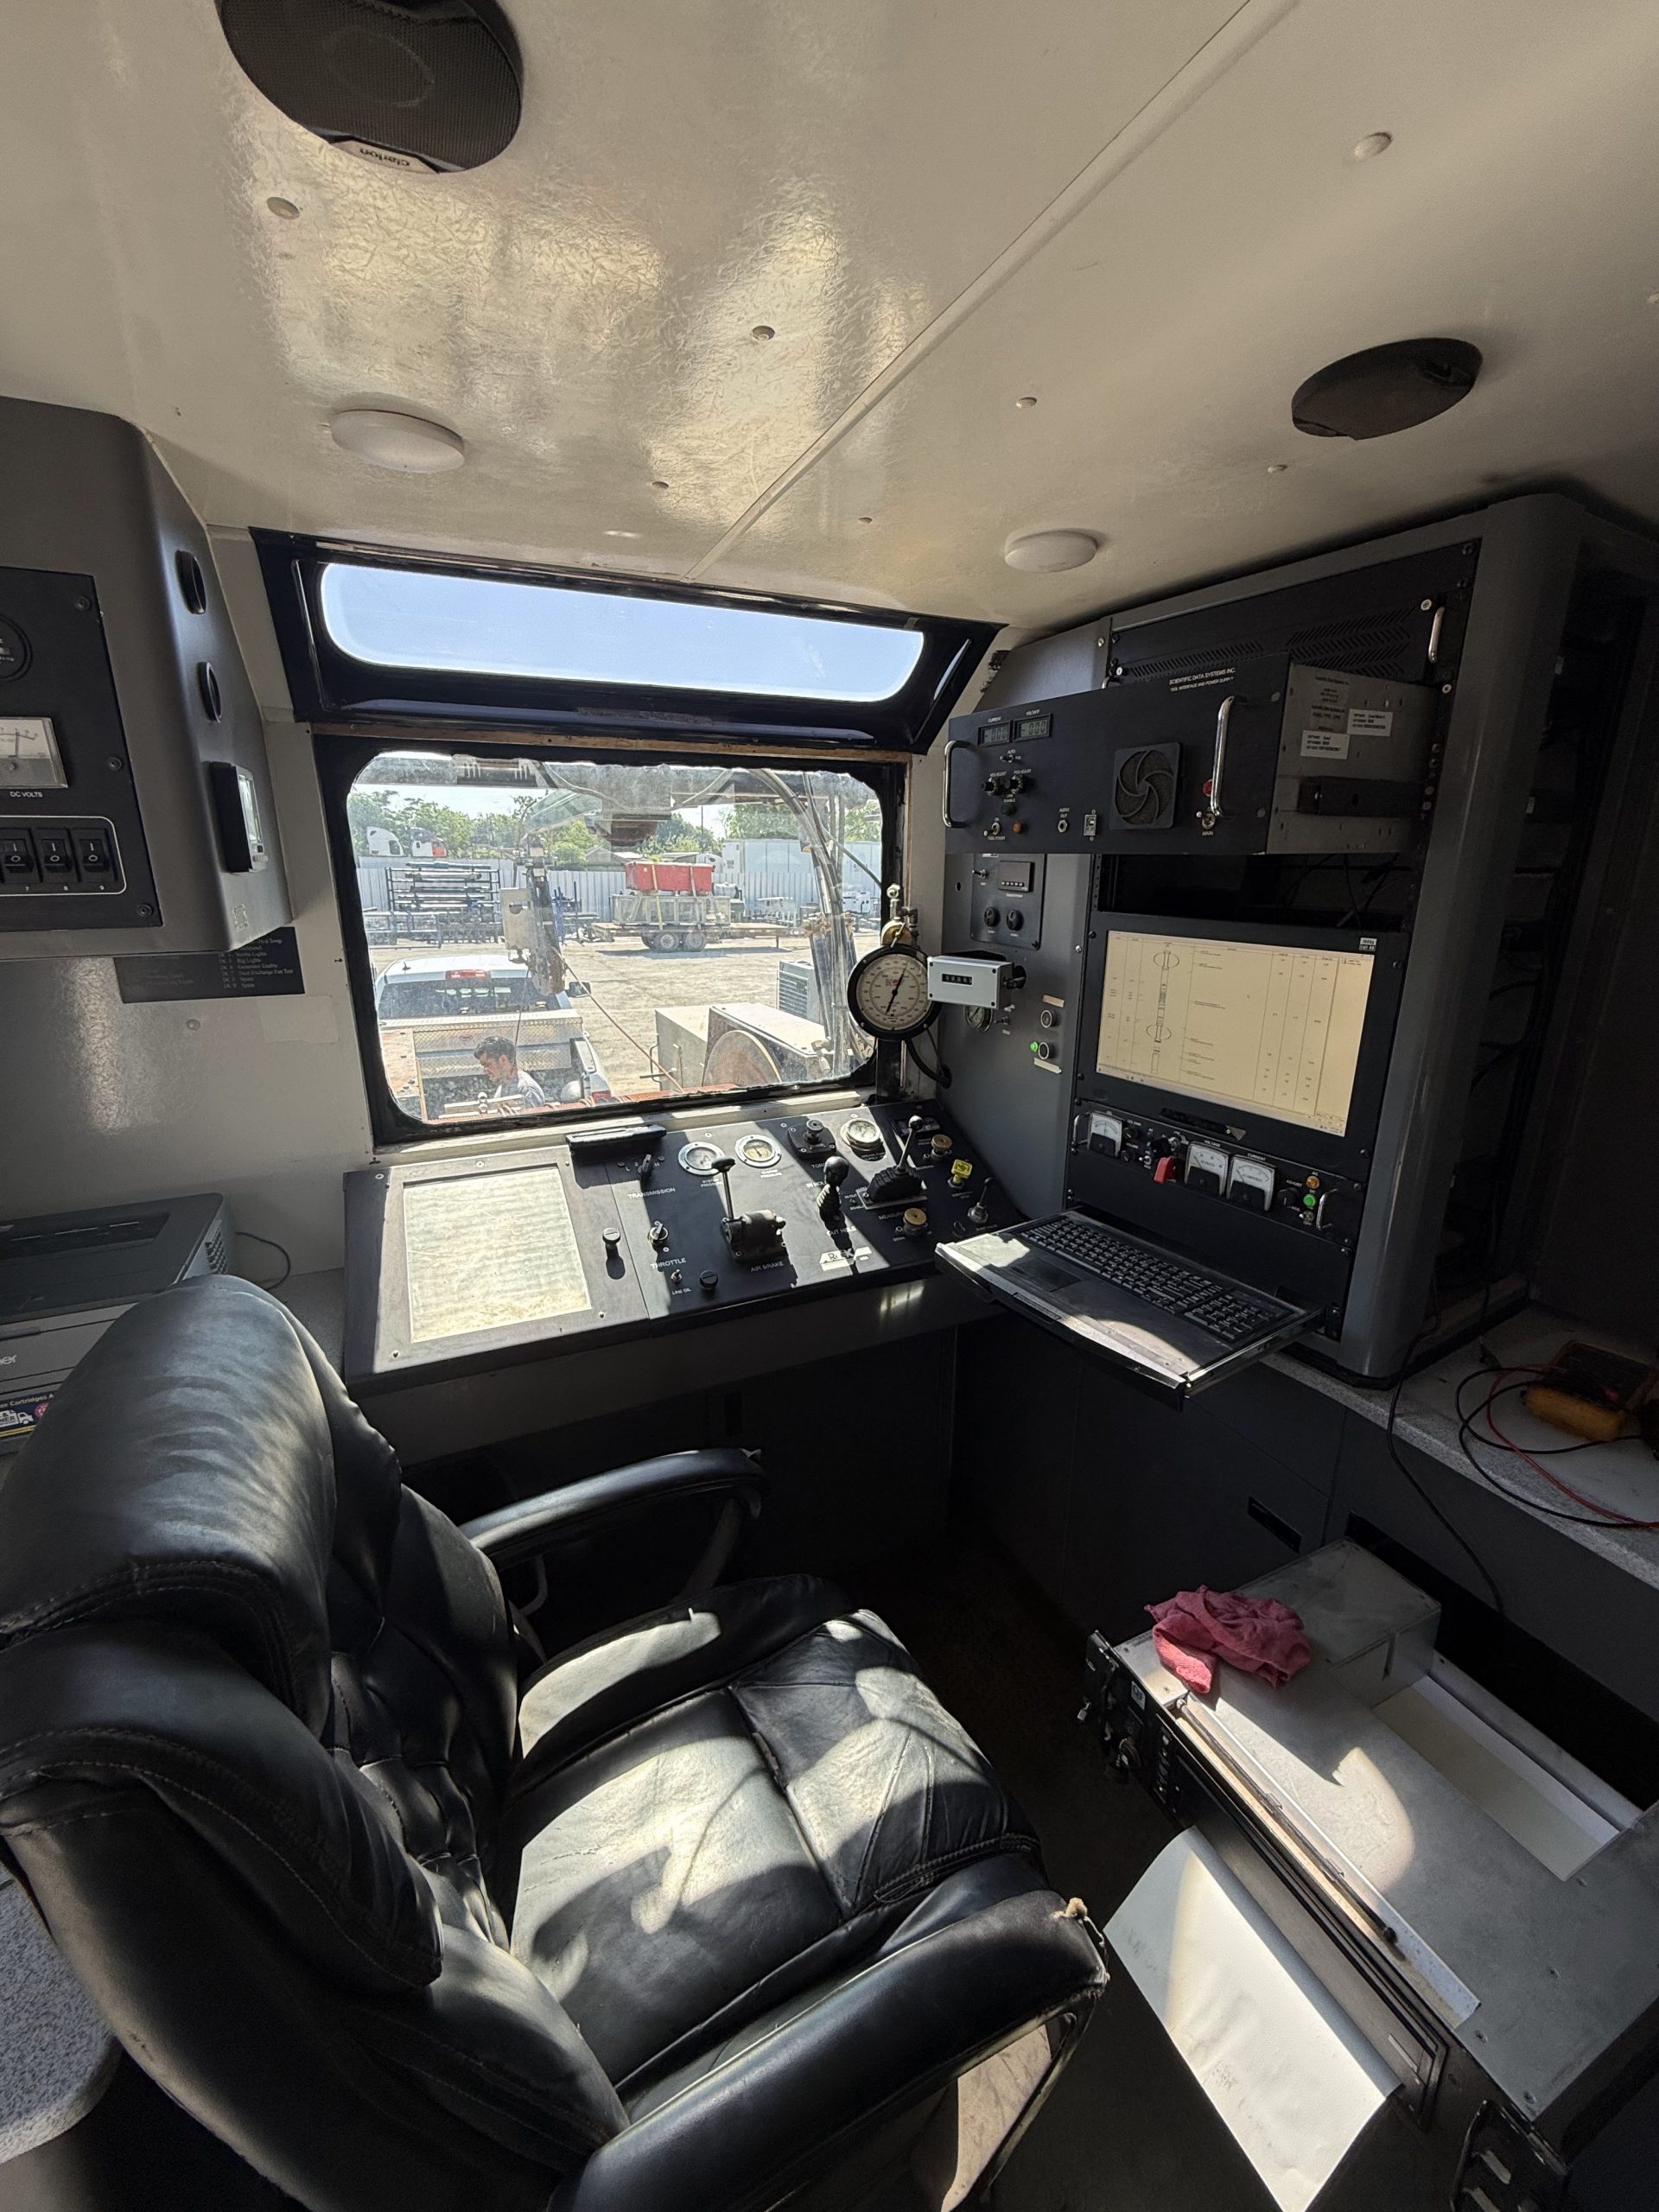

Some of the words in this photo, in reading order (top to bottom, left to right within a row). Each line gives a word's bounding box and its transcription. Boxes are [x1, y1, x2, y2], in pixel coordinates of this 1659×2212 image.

[359, 148, 410, 167] Clarion
[1169, 676, 1192, 685] SCIENTIFIC
[1192, 672, 1205, 681] DATA
[1205, 669, 1225, 678] SYSTEMS
[627, 1187, 676, 1199] TRANSMISSION
[650, 1257, 687, 1269] THROTTLE
[763, 1261, 785, 1270] BRAKE
[10, 1395, 48, 1406] Cartridges
